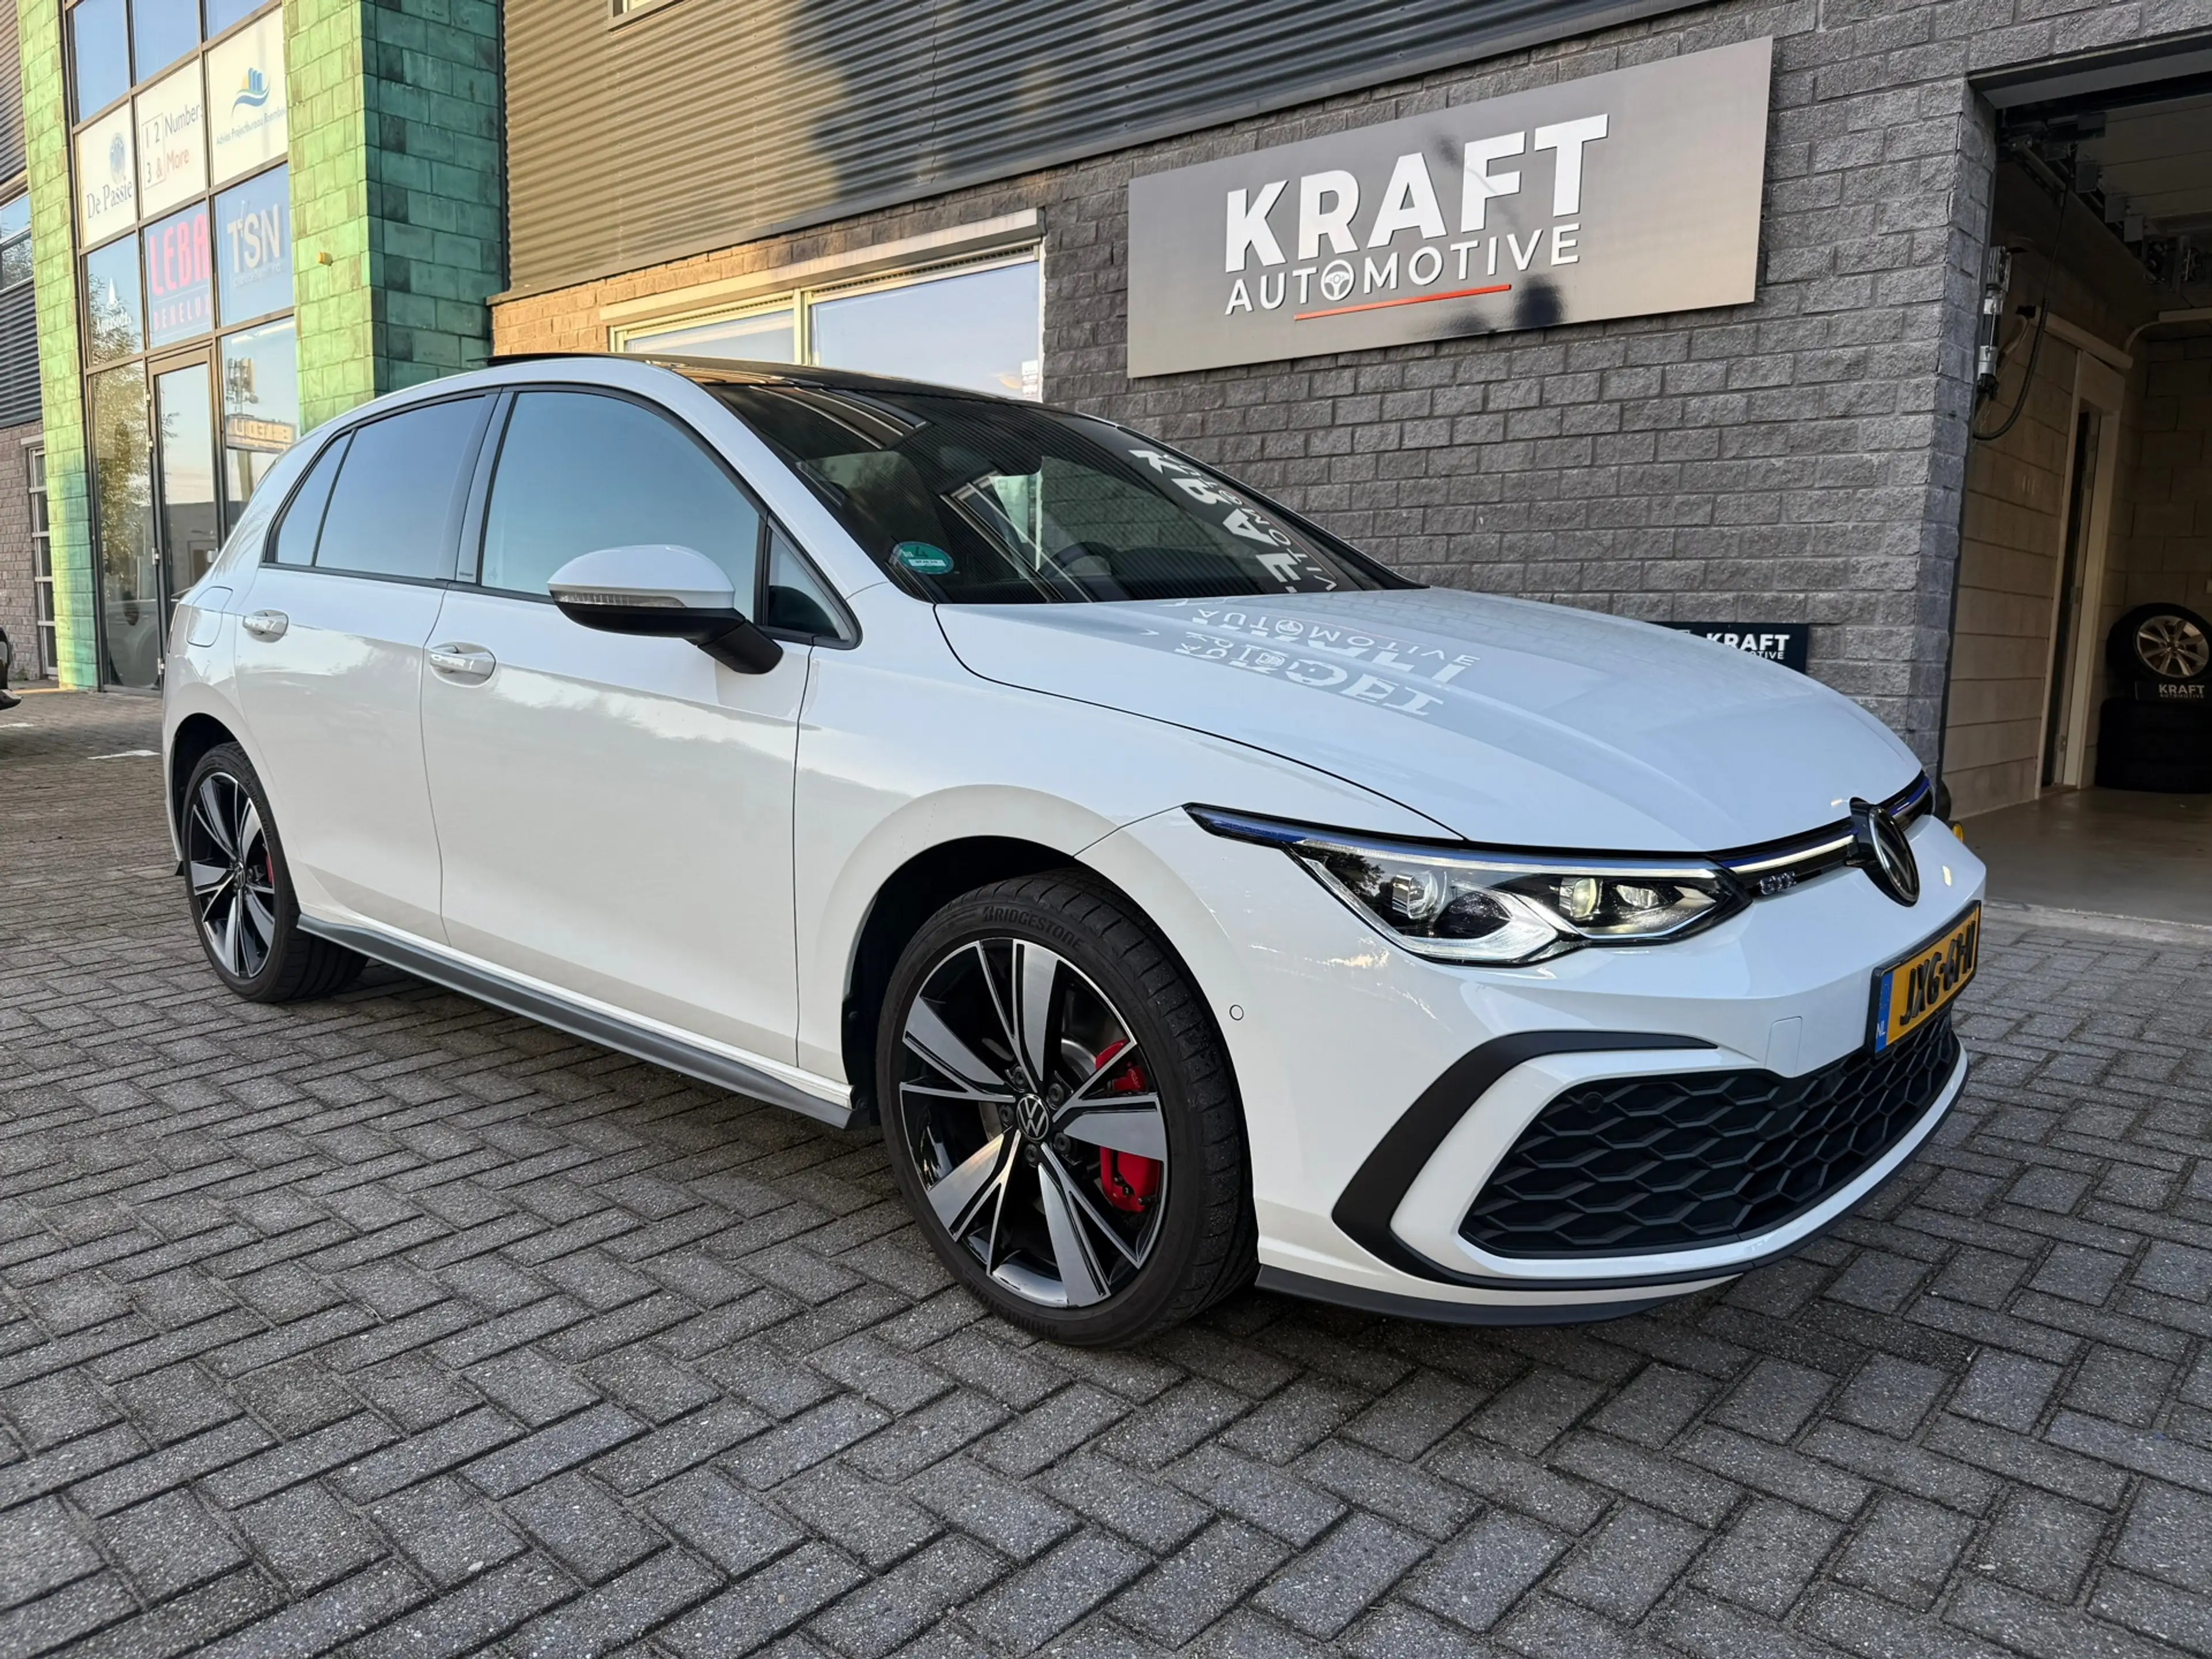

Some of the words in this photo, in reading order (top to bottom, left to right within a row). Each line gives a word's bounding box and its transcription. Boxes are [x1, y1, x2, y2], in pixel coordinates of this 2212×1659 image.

[166, 149, 189, 173] More
[86, 193, 101, 219] De
[103, 175, 132, 211] Passie
[1225, 113, 1609, 274] KRAFT
[227, 203, 281, 273] TSN
[1225, 222, 1581, 316] AUTOMOTIVE
[2158, 684, 2205, 694] KRAFT
[982, 905, 1085, 951] BRIDGESTONE
